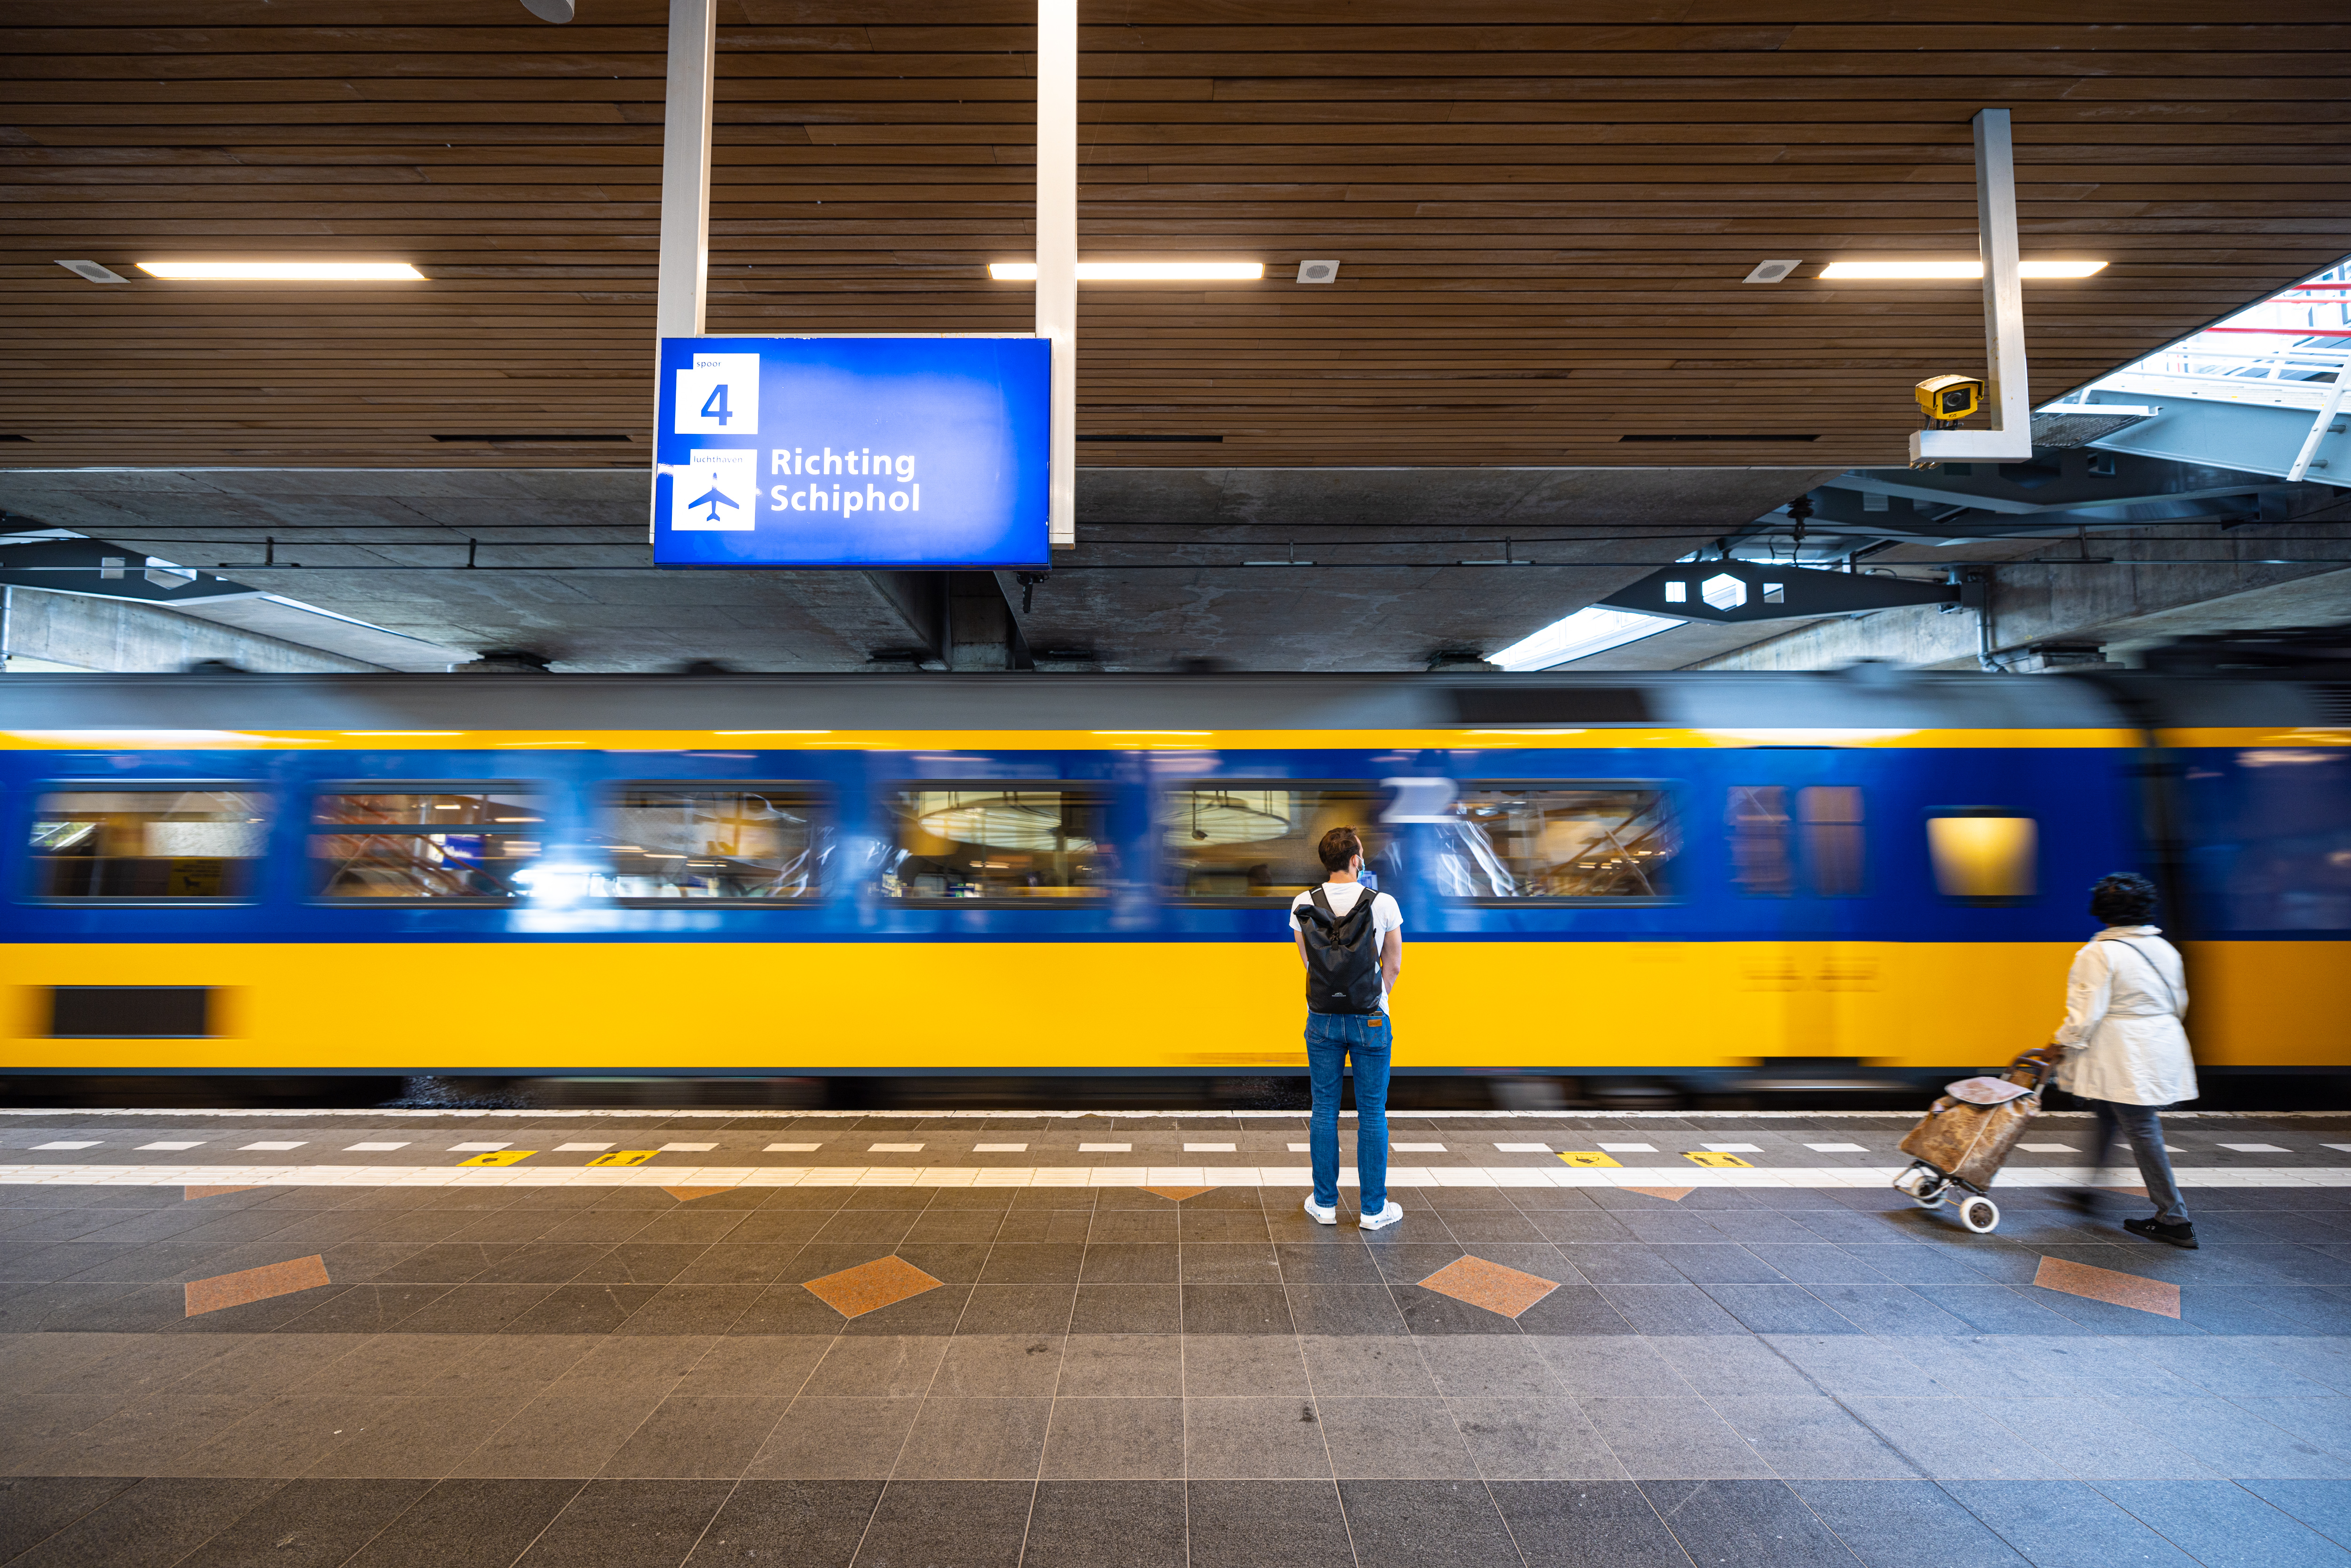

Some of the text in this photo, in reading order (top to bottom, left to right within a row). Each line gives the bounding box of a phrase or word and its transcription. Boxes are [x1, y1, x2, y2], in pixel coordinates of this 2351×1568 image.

[701, 384, 733, 425] 4
[771, 447, 915, 482] Richting
[771, 483, 920, 518] Schiphol
